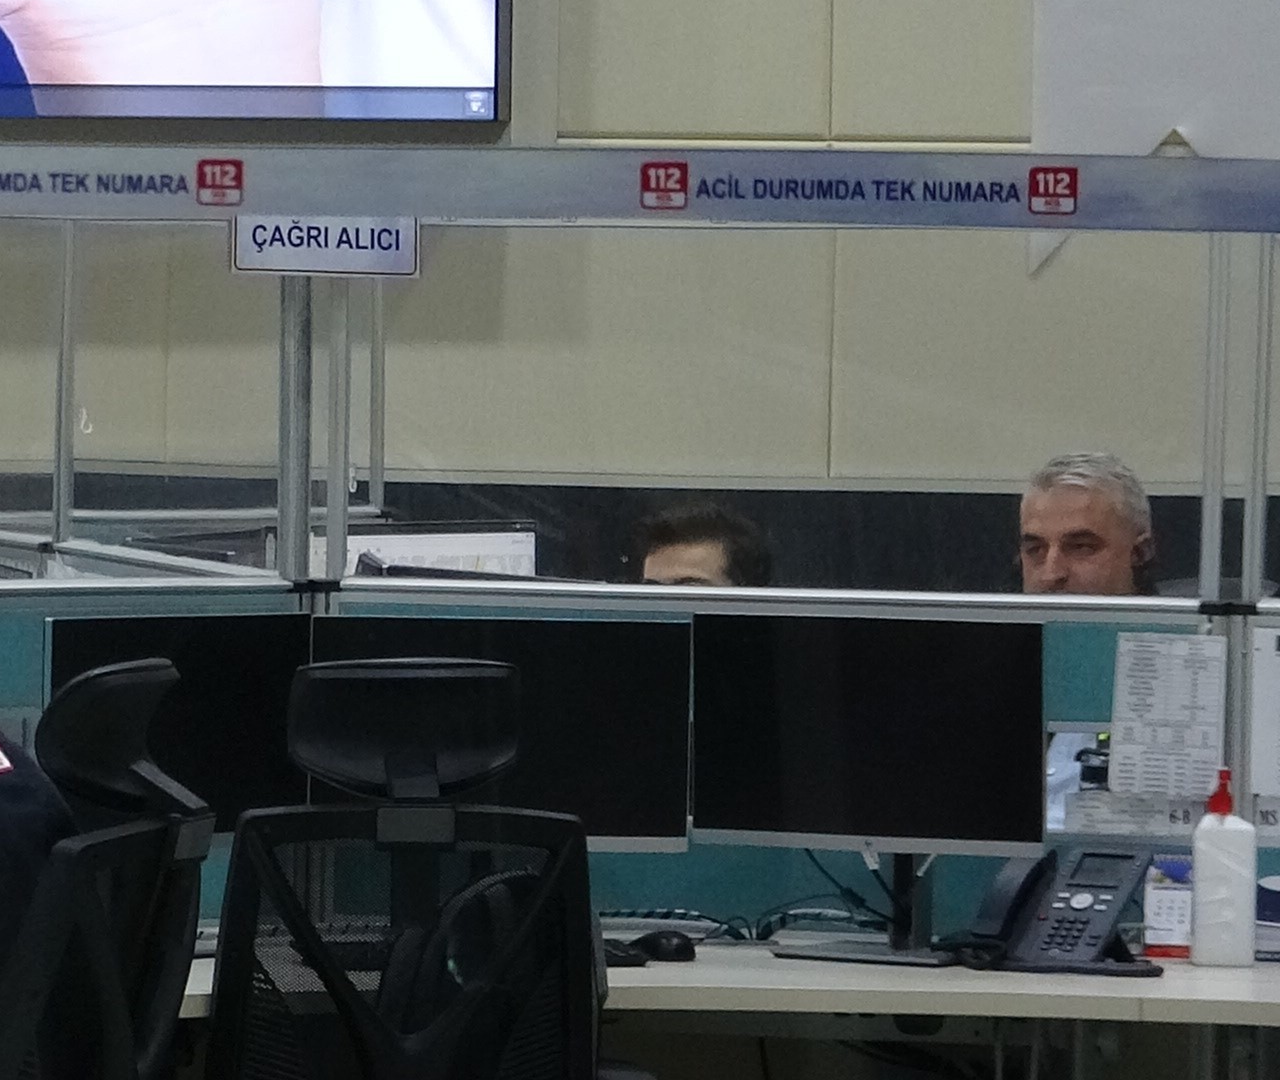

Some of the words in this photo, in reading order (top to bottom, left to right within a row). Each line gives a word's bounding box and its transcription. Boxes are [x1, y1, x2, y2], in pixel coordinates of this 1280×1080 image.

[49, 172, 89, 194] TEK
[96, 173, 189, 195] NUMARA
[204, 165, 235, 187] 112
[648, 167, 680, 190] 112
[696, 174, 745, 199] ACİL
[753, 178, 866, 201] DURUMDA
[874, 179, 915, 202] TEK
[922, 180, 1020, 204] NUMARA
[1037, 172, 1070, 196] 112
[252, 220, 329, 253] ÇAĞRI
[336, 227, 400, 251] ALICI
